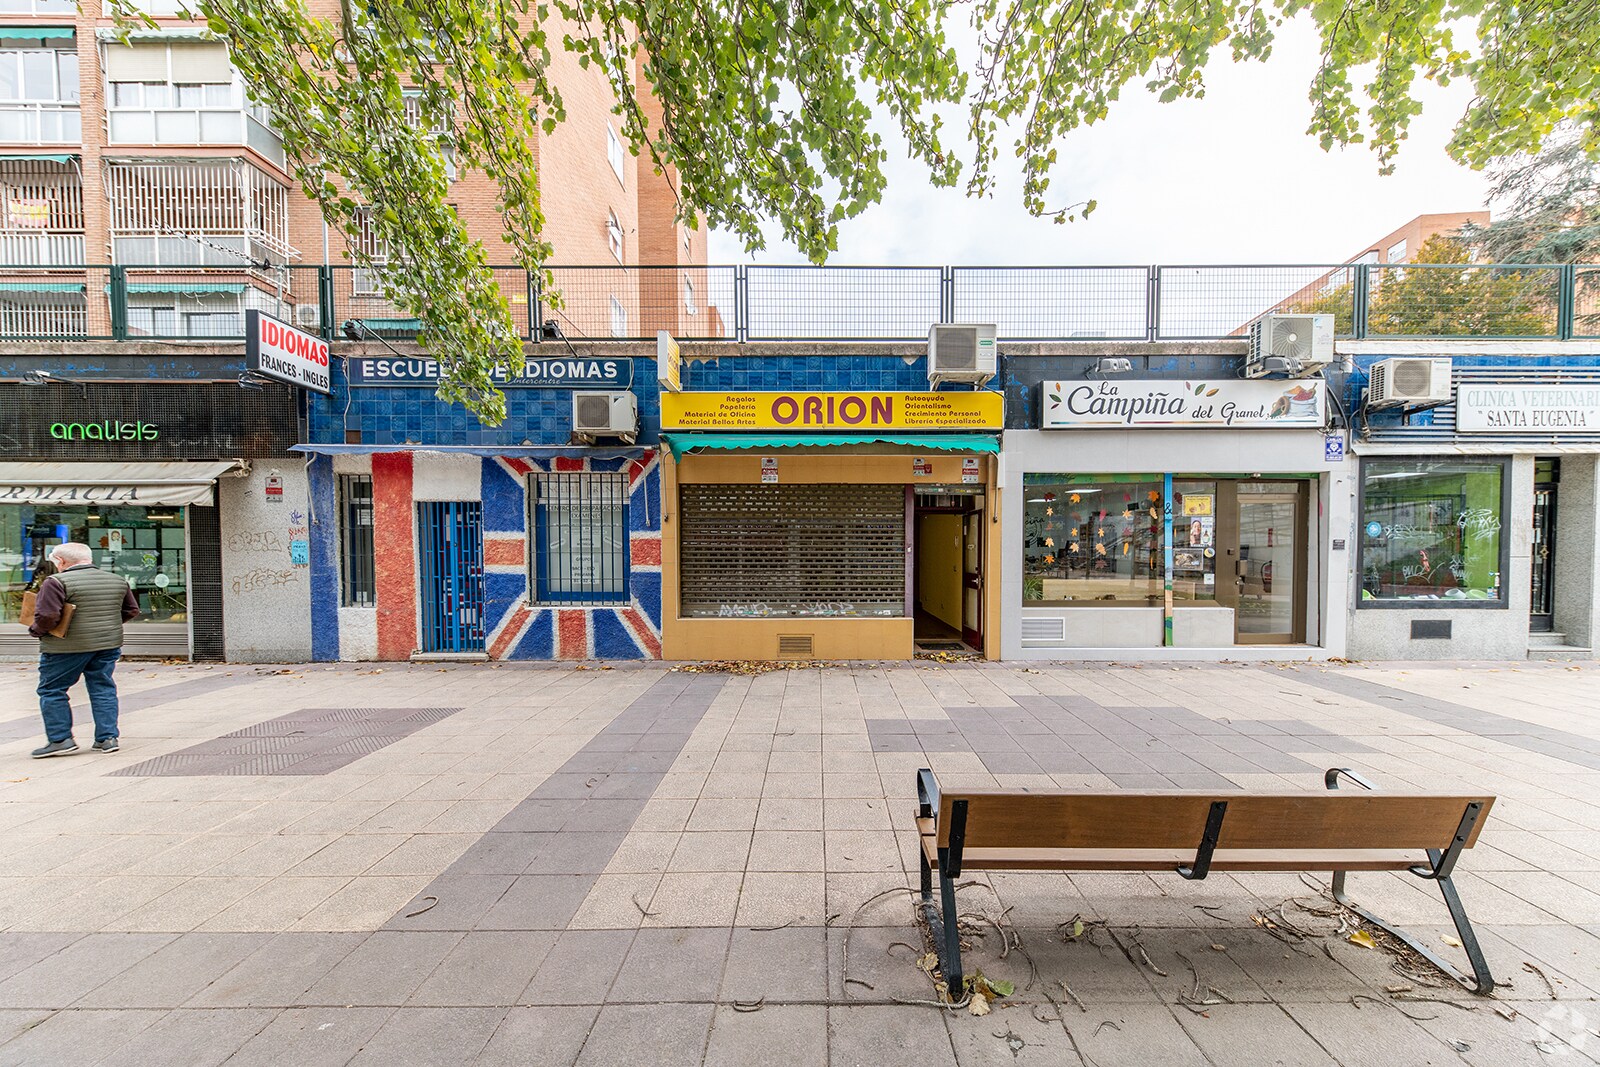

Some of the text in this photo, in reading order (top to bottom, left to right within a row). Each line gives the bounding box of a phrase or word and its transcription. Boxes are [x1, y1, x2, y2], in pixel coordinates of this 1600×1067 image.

[262, 319, 328, 367] IDIOMAS
[261, 353, 297, 378] FRANCES
[303, 369, 328, 389] INGLES
[362, 361, 466, 378] ESCUEL
[1099, 381, 1118, 396] La
[771, 396, 893, 425] ORION
[1067, 386, 1188, 424] Campiña
[1192, 401, 1264, 425] del Granel
[1487, 410, 1527, 427] SANTA
[1532, 410, 1587, 427] EUGENIA
[50, 420, 159, 441] analisis
[1, 486, 139, 501] RMACIA
